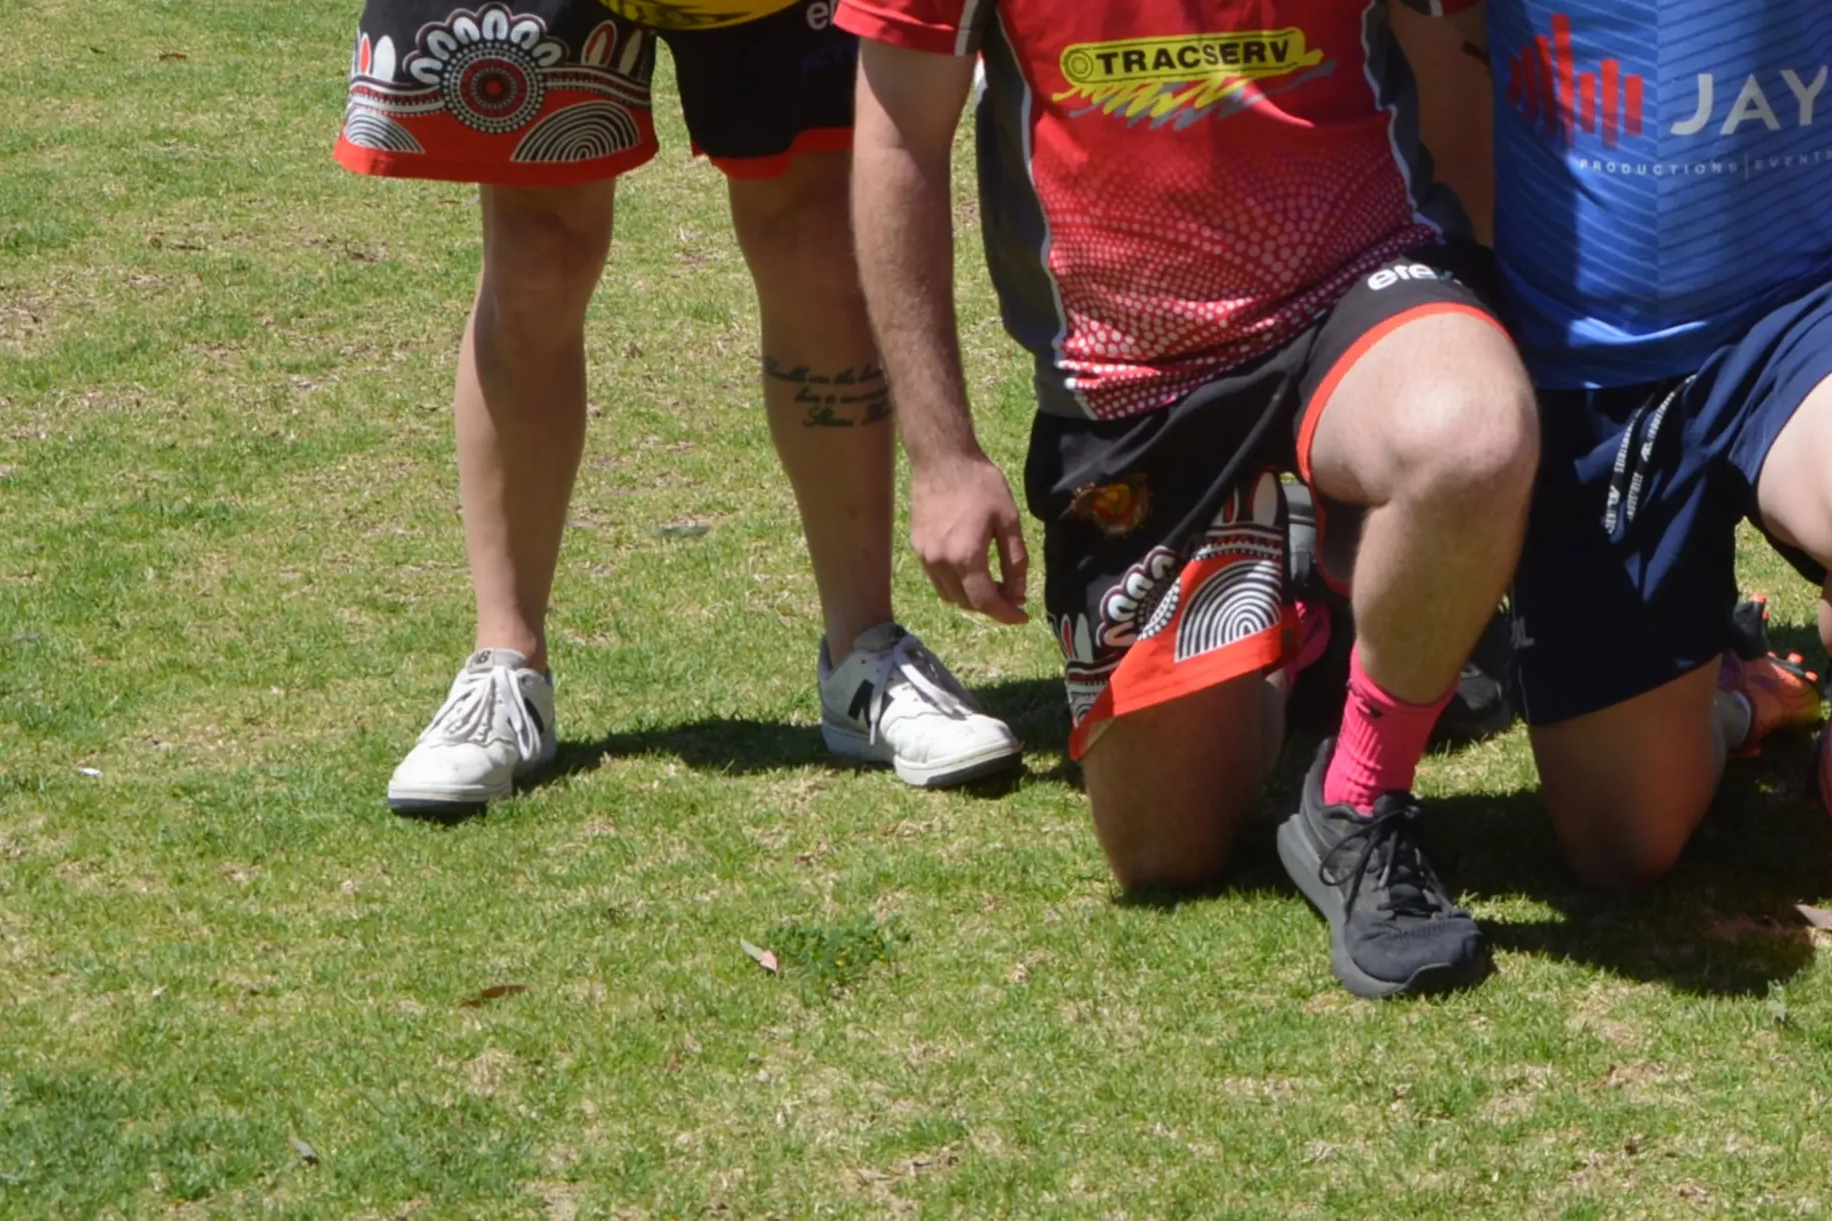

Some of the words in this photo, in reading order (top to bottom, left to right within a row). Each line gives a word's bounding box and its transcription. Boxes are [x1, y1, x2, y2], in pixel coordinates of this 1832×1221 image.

[1095, 39, 1290, 75] TRACSERV
[1670, 65, 1828, 136] JAY
[1579, 158, 1737, 177] PRODUCTIONS
